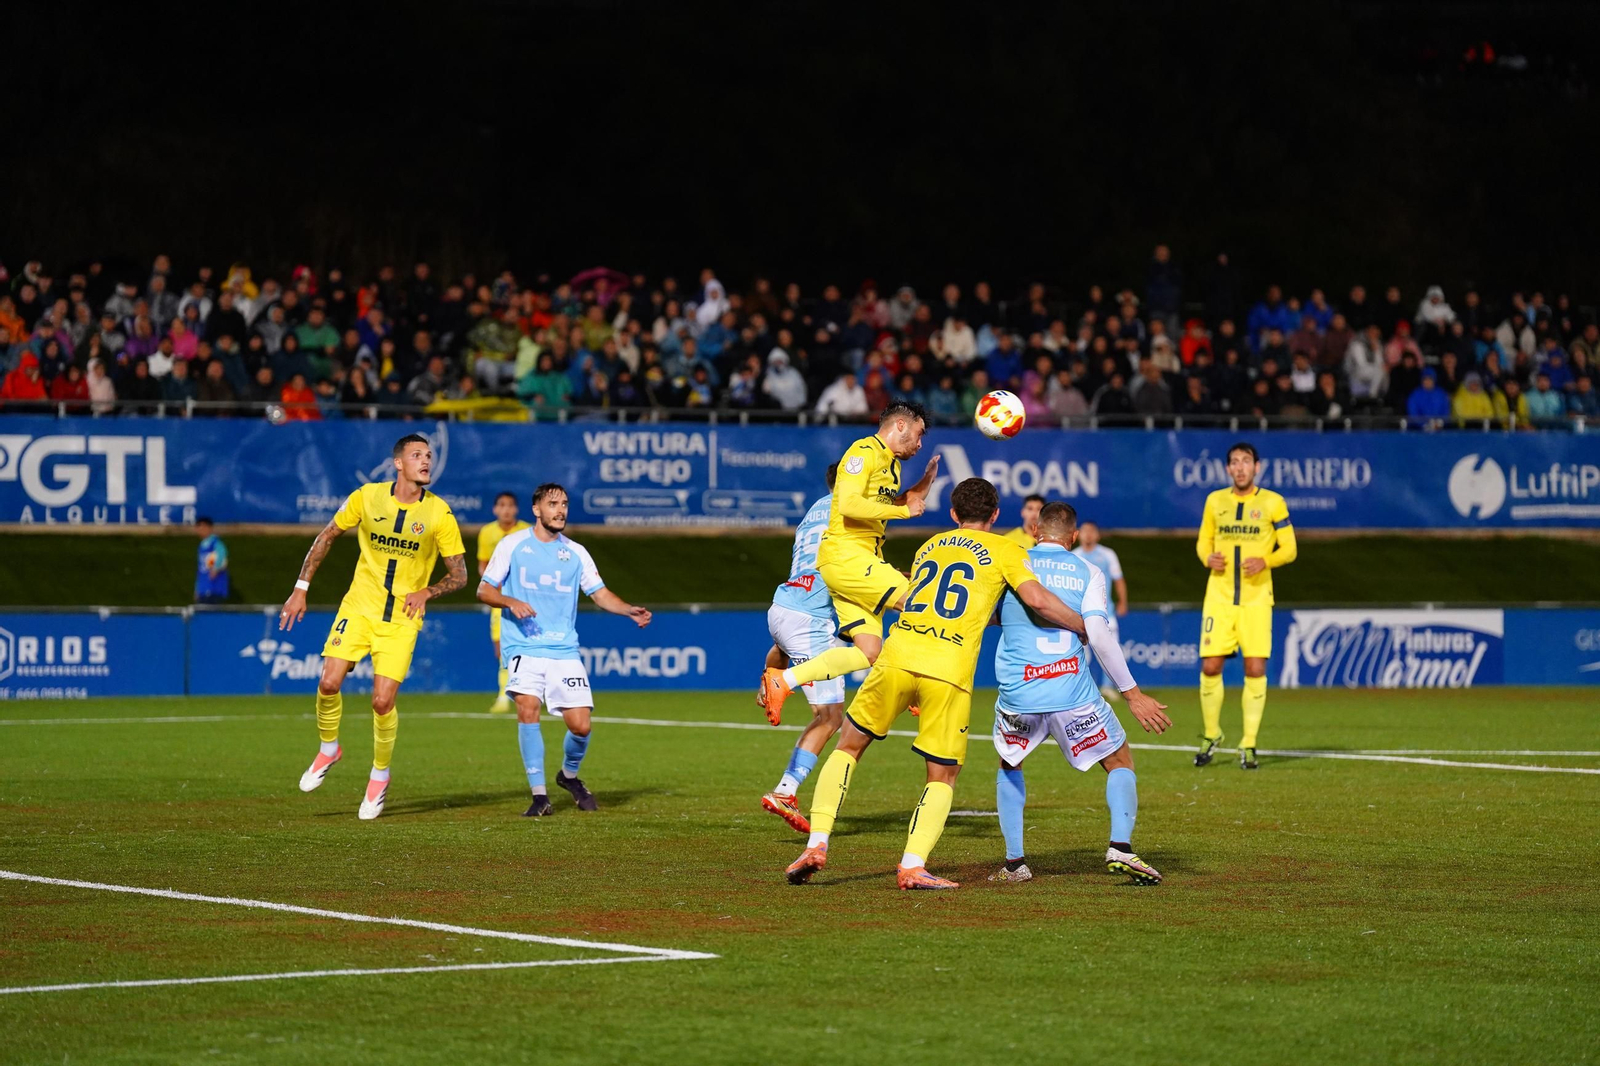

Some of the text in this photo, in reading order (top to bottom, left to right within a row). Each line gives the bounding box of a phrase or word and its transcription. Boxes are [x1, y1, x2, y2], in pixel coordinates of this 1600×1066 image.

[583, 431, 706, 455] VENTURA
[20, 435, 197, 508] GTL
[600, 458, 692, 486] ESPEJO
[1273, 457, 1372, 490] PAREJO
[20, 504, 197, 525] ALQUILER
[370, 532, 420, 551] PAMESA
[1218, 525, 1261, 535] PAMESA
[914, 536, 992, 566] PAU NAVARRO
[903, 560, 975, 620] 26
[1046, 573, 1085, 592] AGUDO
[335, 618, 348, 635] 4
[18, 635, 108, 664] RIOS
[1393, 628, 1475, 653] Pinturas
[511, 655, 522, 673] 7
[1026, 660, 1077, 679] CAMPOARAS
[567, 677, 589, 688] GTL
[1073, 731, 1106, 754] CAMPOARAS
